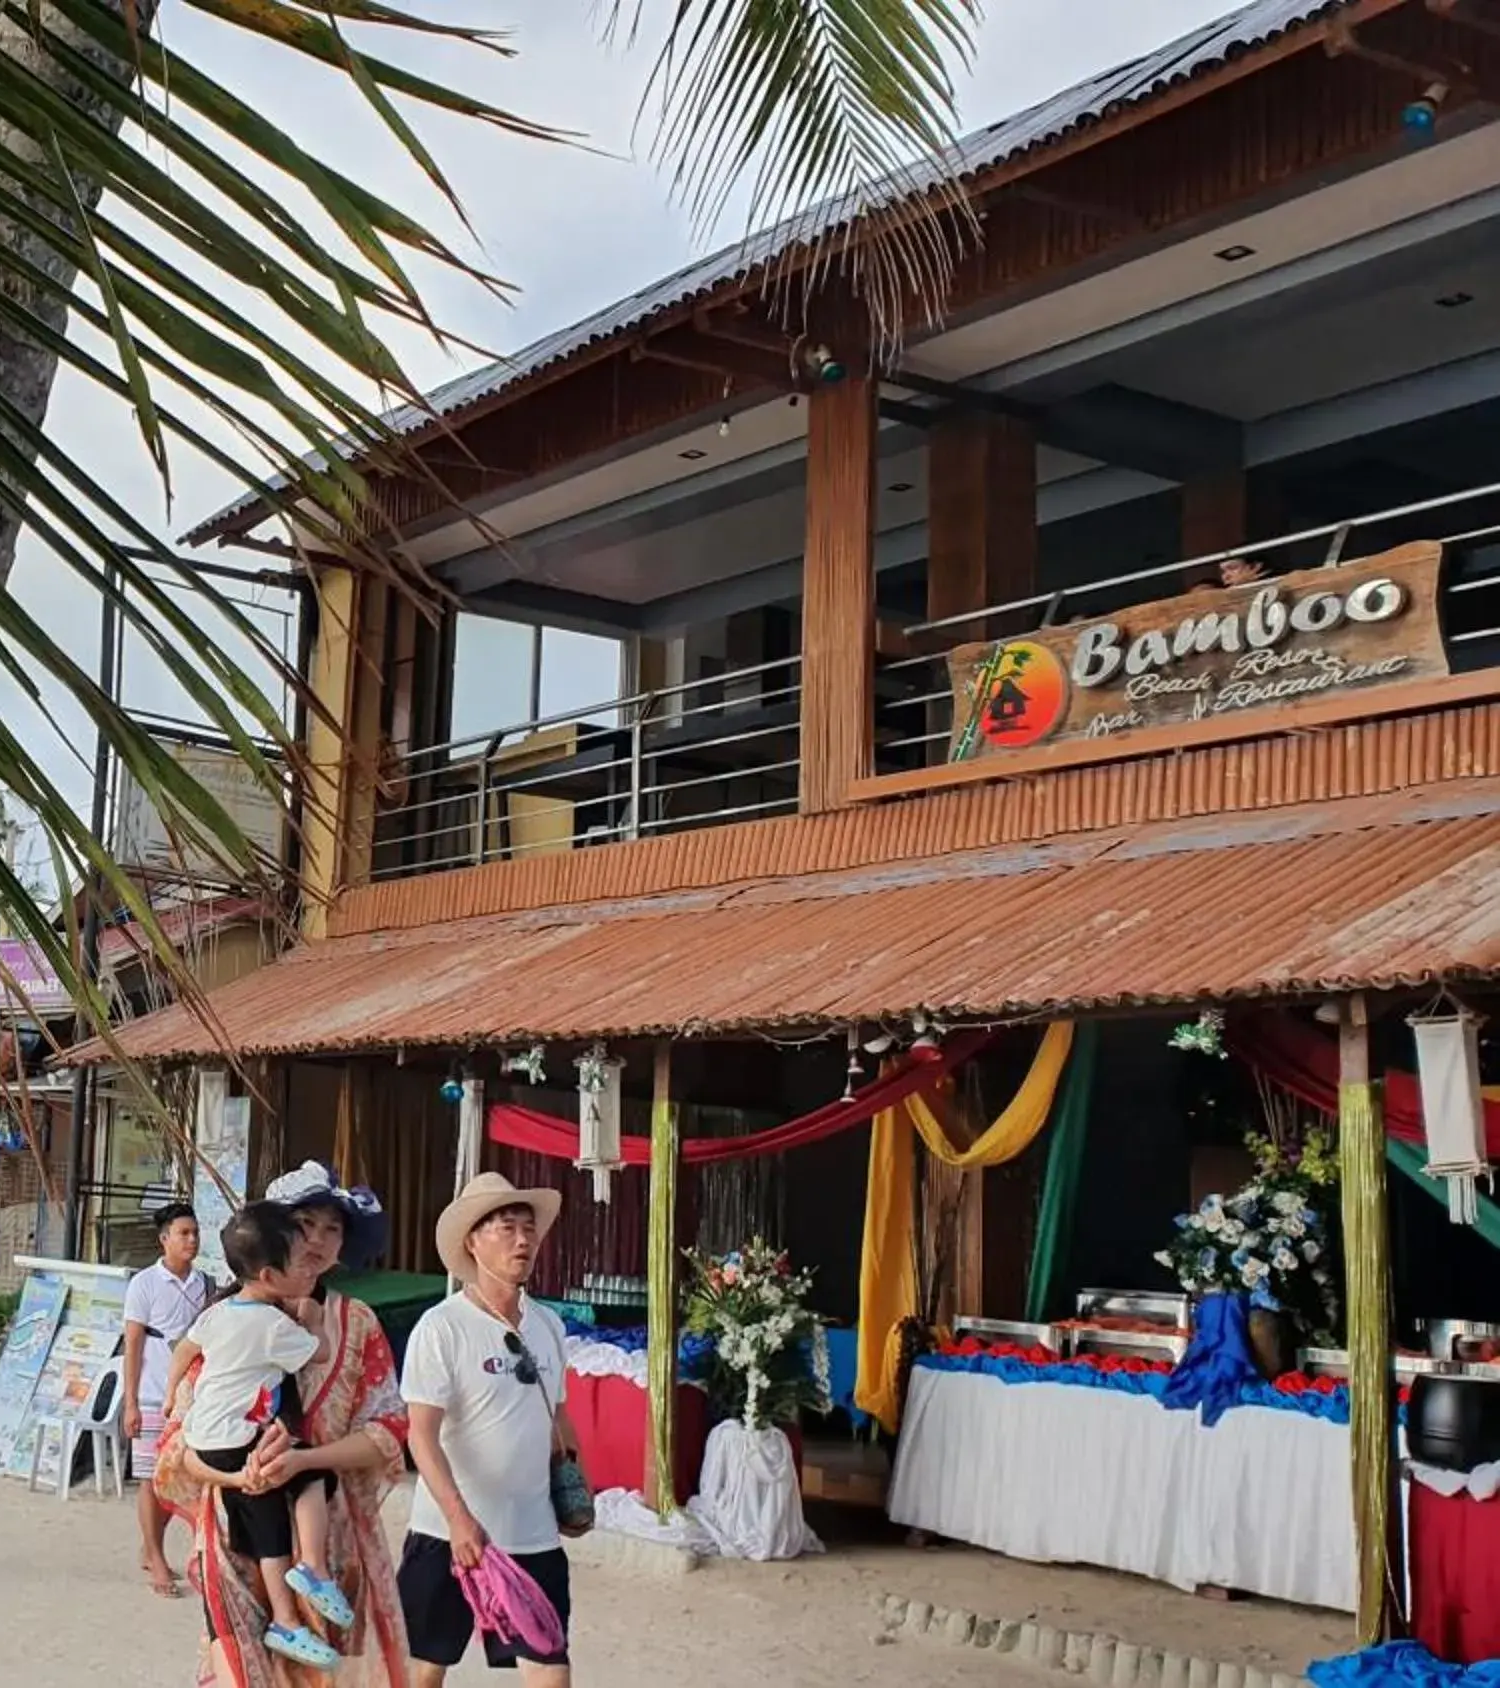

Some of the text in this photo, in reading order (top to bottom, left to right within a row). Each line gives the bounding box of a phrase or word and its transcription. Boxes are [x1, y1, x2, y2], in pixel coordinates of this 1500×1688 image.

[1072, 578, 1405, 688] Bamboo
[1125, 671, 1212, 702] Beach
[1213, 655, 1409, 711] Restaurant
